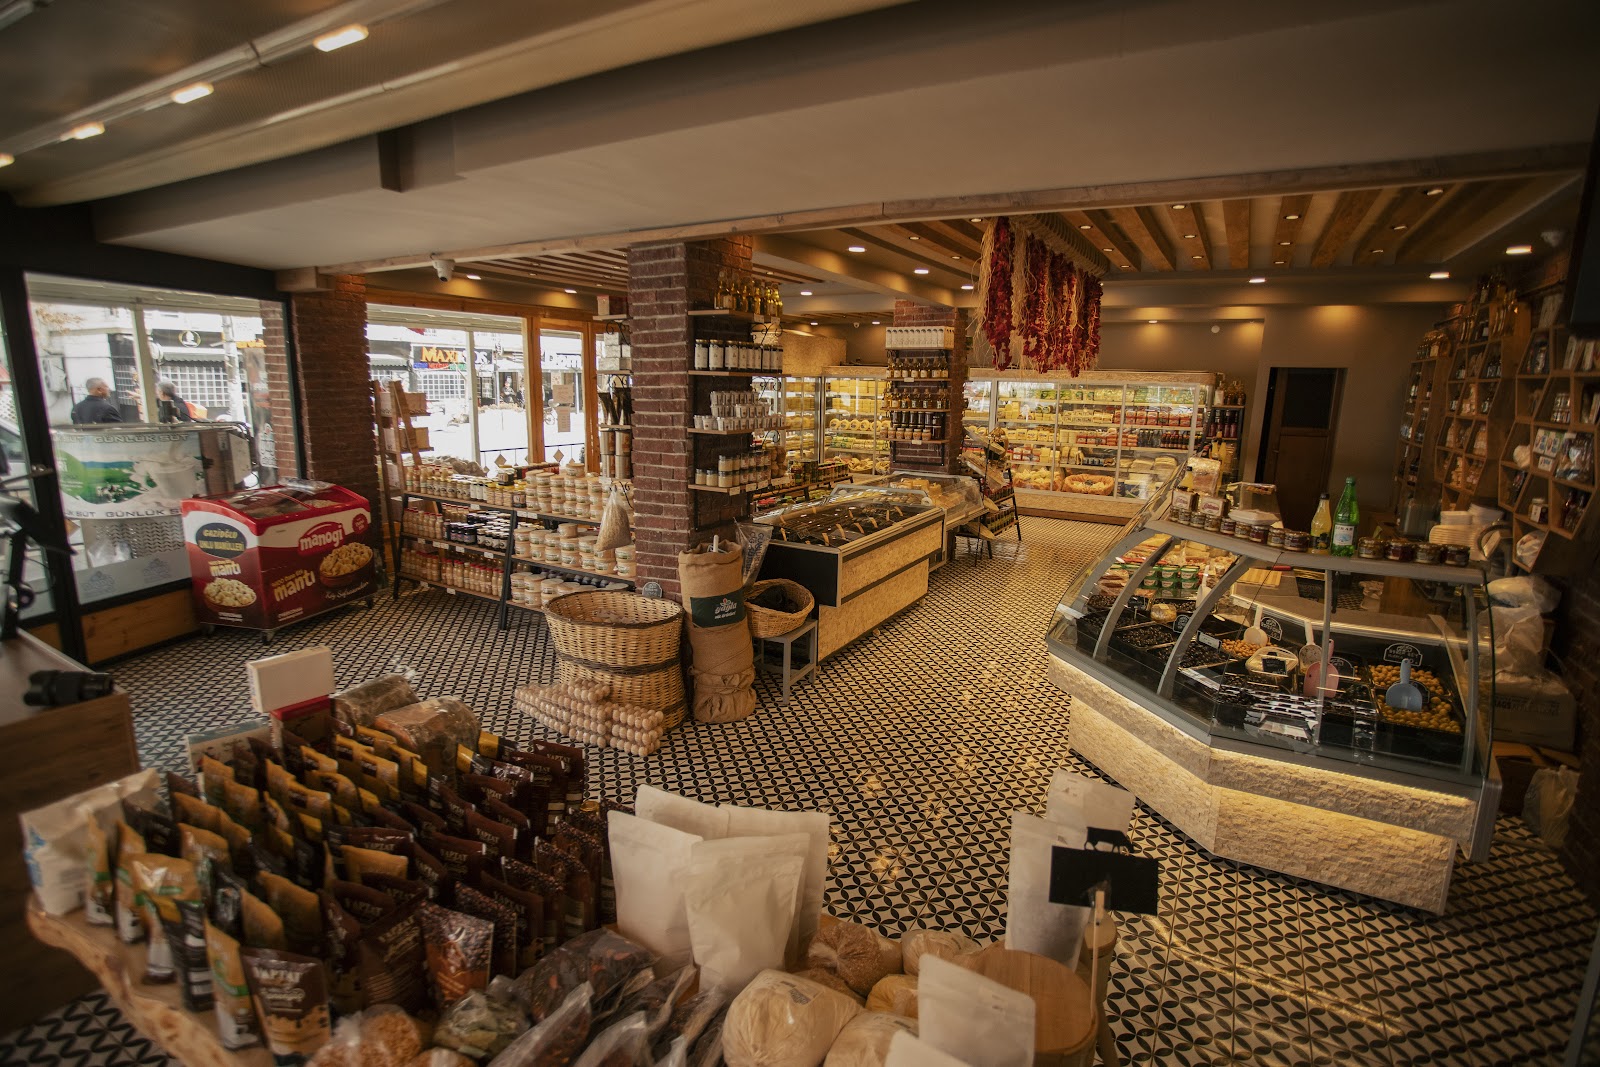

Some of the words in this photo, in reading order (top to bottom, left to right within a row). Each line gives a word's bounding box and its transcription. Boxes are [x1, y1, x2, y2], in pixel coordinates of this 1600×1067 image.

[94, 434, 156, 443] GÜNLÜK
[159, 433, 189, 442] SÜT
[105, 508, 166, 518] GÜNLÜK
[299, 524, 343, 551] manogi
[209, 562, 242, 577] mantı
[273, 570, 316, 602] mantı
